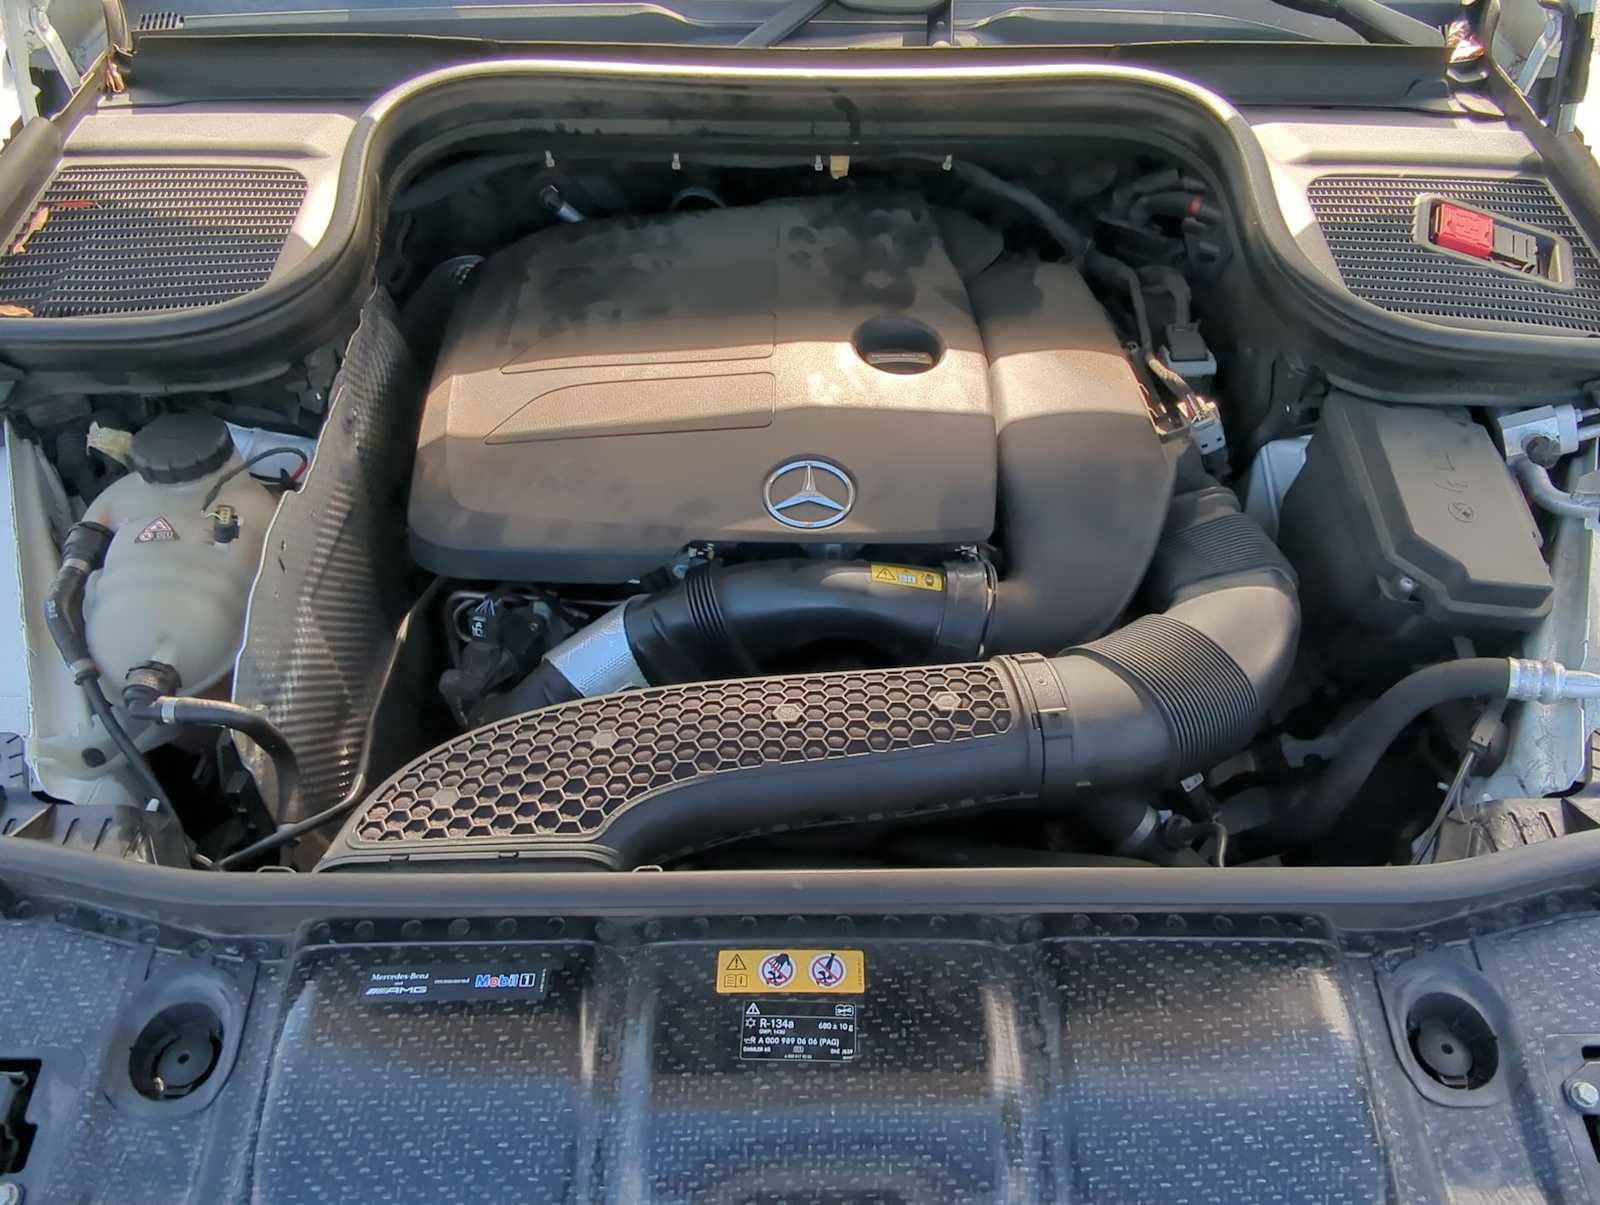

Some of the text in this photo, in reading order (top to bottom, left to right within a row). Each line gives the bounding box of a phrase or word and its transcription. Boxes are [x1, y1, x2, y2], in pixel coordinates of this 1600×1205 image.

[371, 972, 430, 981] Mercedes-Benz
[475, 974, 519, 987] Mobil
[383, 985, 428, 994] AMG
[759, 1018, 794, 1029] R-134a
[765, 1037, 779, 1045] 000
